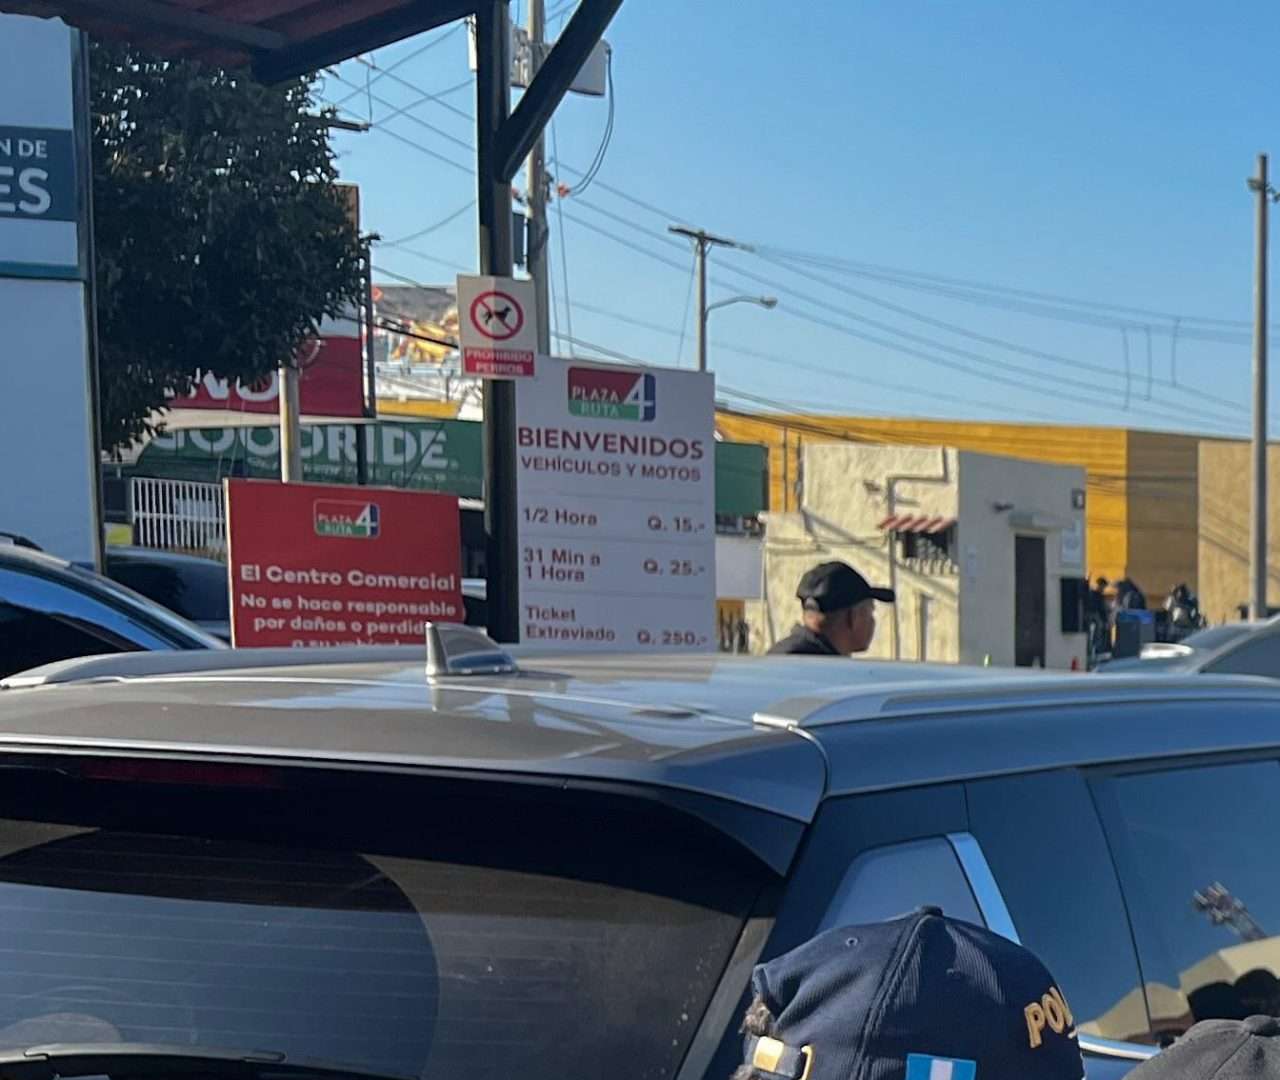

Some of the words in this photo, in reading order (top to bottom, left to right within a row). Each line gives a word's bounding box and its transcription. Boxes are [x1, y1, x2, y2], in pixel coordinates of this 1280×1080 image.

[19, 140, 48, 158] DE
[0, 166, 51, 214] ES
[572, 386, 619, 403] PLAZA
[580, 402, 620, 417] RUTA
[518, 427, 704, 460] BIENVENIDOS
[521, 455, 621, 477] VEHÍCULOS
[626, 461, 637, 475] Y
[641, 465, 702, 482] MOTOS
[524, 507, 549, 524] 1/2
[555, 509, 597, 526] Hora
[524, 548, 544, 563] 31
[551, 548, 585, 566] Min
[241, 564, 259, 581] El
[266, 566, 342, 585] Centro
[348, 570, 455, 591] Comercial
[526, 565, 533, 580] 1
[541, 566, 585, 582] Hora
[241, 593, 267, 608] No
[272, 597, 292, 609] se
[298, 596, 342, 612] hace
[348, 599, 456, 617] responsable
[526, 605, 576, 621] Ticket
[254, 617, 285, 632] por
[291, 616, 345, 633] daños
[351, 621, 362, 632] o
[526, 624, 616, 642] Extraviado
